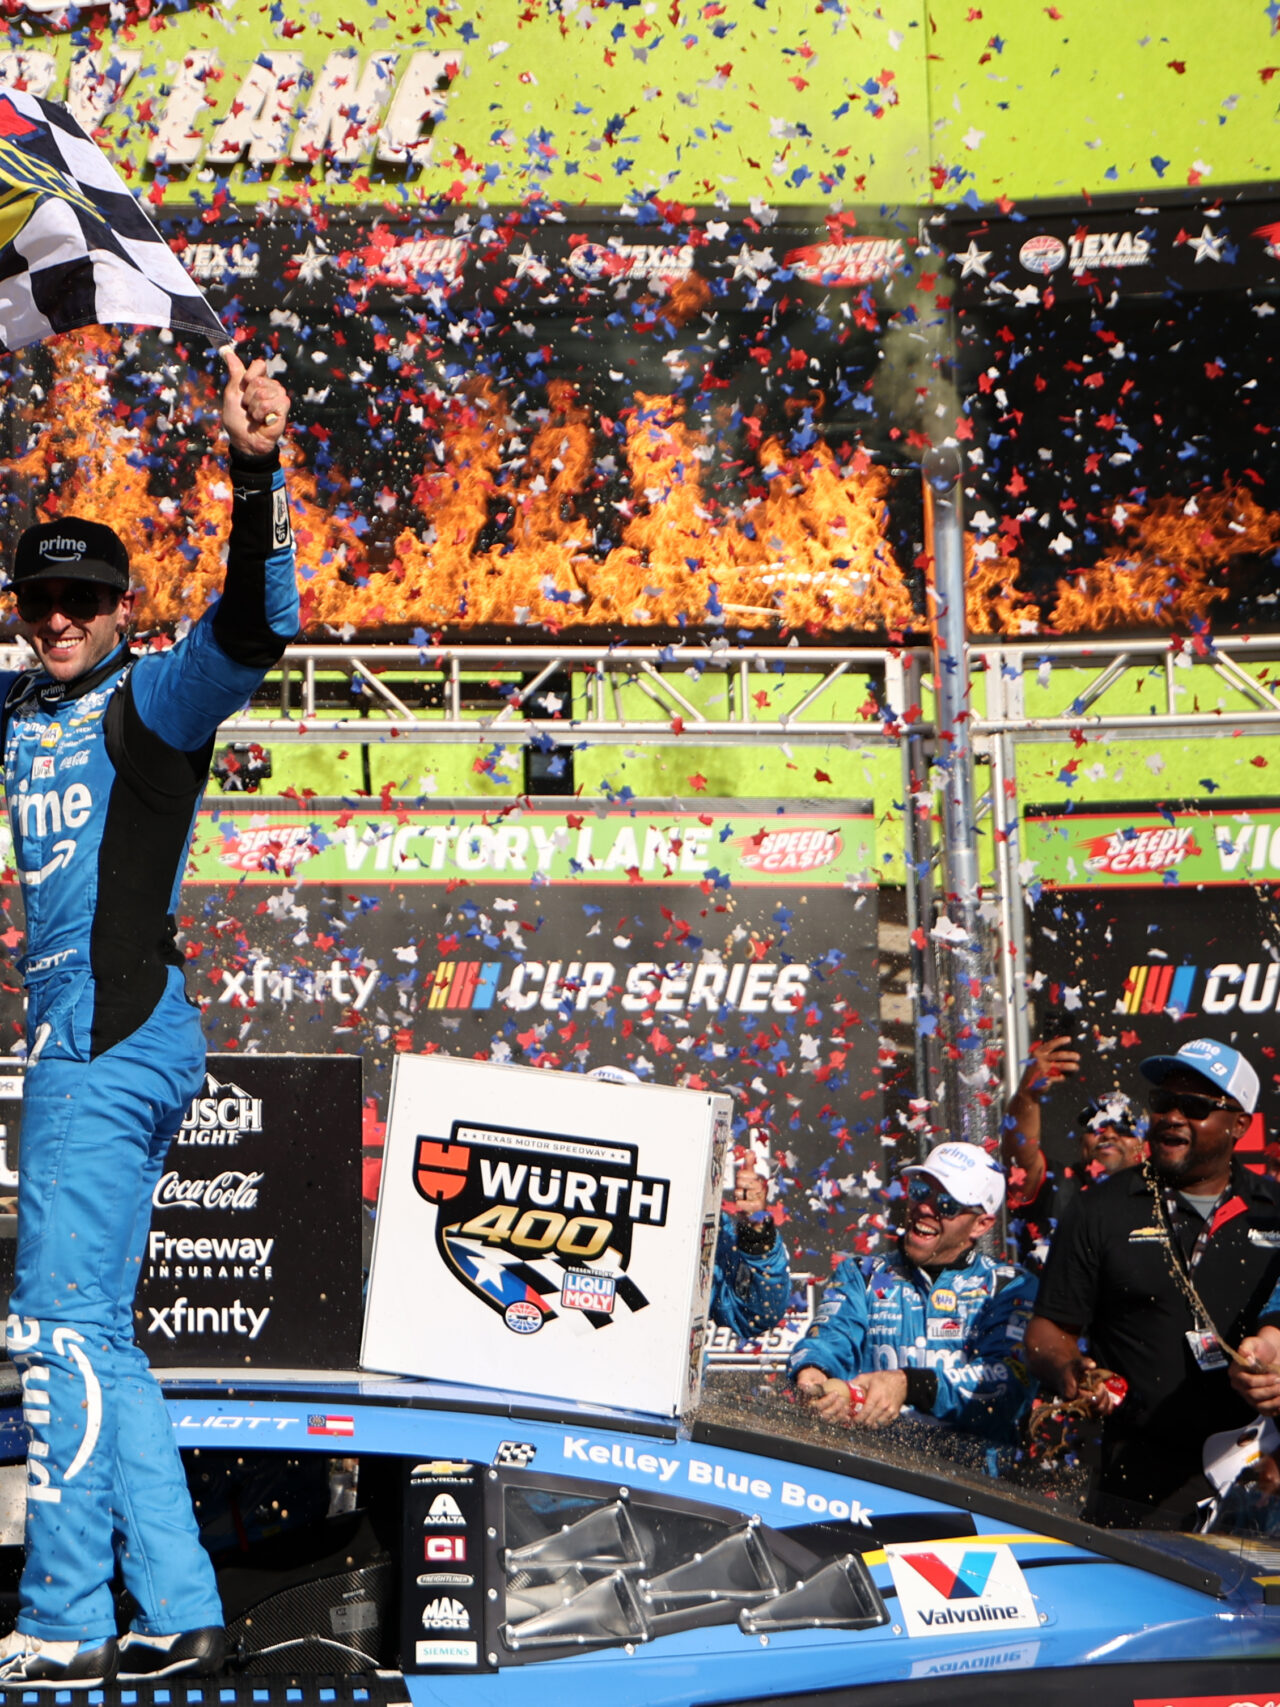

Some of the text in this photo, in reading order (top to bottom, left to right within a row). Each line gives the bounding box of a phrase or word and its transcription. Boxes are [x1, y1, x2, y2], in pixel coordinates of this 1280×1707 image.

[147, 50, 463, 164] LANE
[1069, 231, 1150, 258] TEXAS
[39, 536, 87, 555] prime
[41, 684, 66, 698] prime
[9, 779, 93, 837] rime
[237, 827, 310, 851] SPEED
[344, 825, 713, 872] VICTORY LANE
[758, 829, 835, 855] SPEEDY
[505, 962, 811, 1013] CUP SERIES
[1201, 963, 1280, 1014] CU
[181, 1099, 263, 1131] USCH
[177, 1130, 239, 1146] LIGHT
[482, 1133, 607, 1157] TEXAS MOTOR SPEEDWAY
[152, 1171, 264, 1209] Coca-Cola
[479, 1158, 665, 1223] WÜRTH
[461, 1205, 614, 1256] 400
[149, 1231, 274, 1266] Freeway
[149, 1266, 273, 1279] INSURANCE
[567, 1274, 613, 1295] LIQUI
[565, 1290, 612, 1311] MOLY
[148, 1297, 270, 1339] xfinity
[867, 1325, 897, 1335] niFirst
[944, 1359, 1008, 1385] prime
[172, 1416, 300, 1430] LIOTT
[410, 1477, 475, 1485] CHEVROLET
[563, 1436, 874, 1529] Kelley Blue Book
[424, 1515, 467, 1525] AXALTA
[427, 1538, 464, 1559] CI
[422, 1576, 468, 1584] FREIGHTLINER
[423, 1597, 470, 1619] MAC
[917, 1604, 1019, 1627] Valvoline
[423, 1619, 470, 1629] TOOLS
[423, 1647, 470, 1656] SIEMENS
